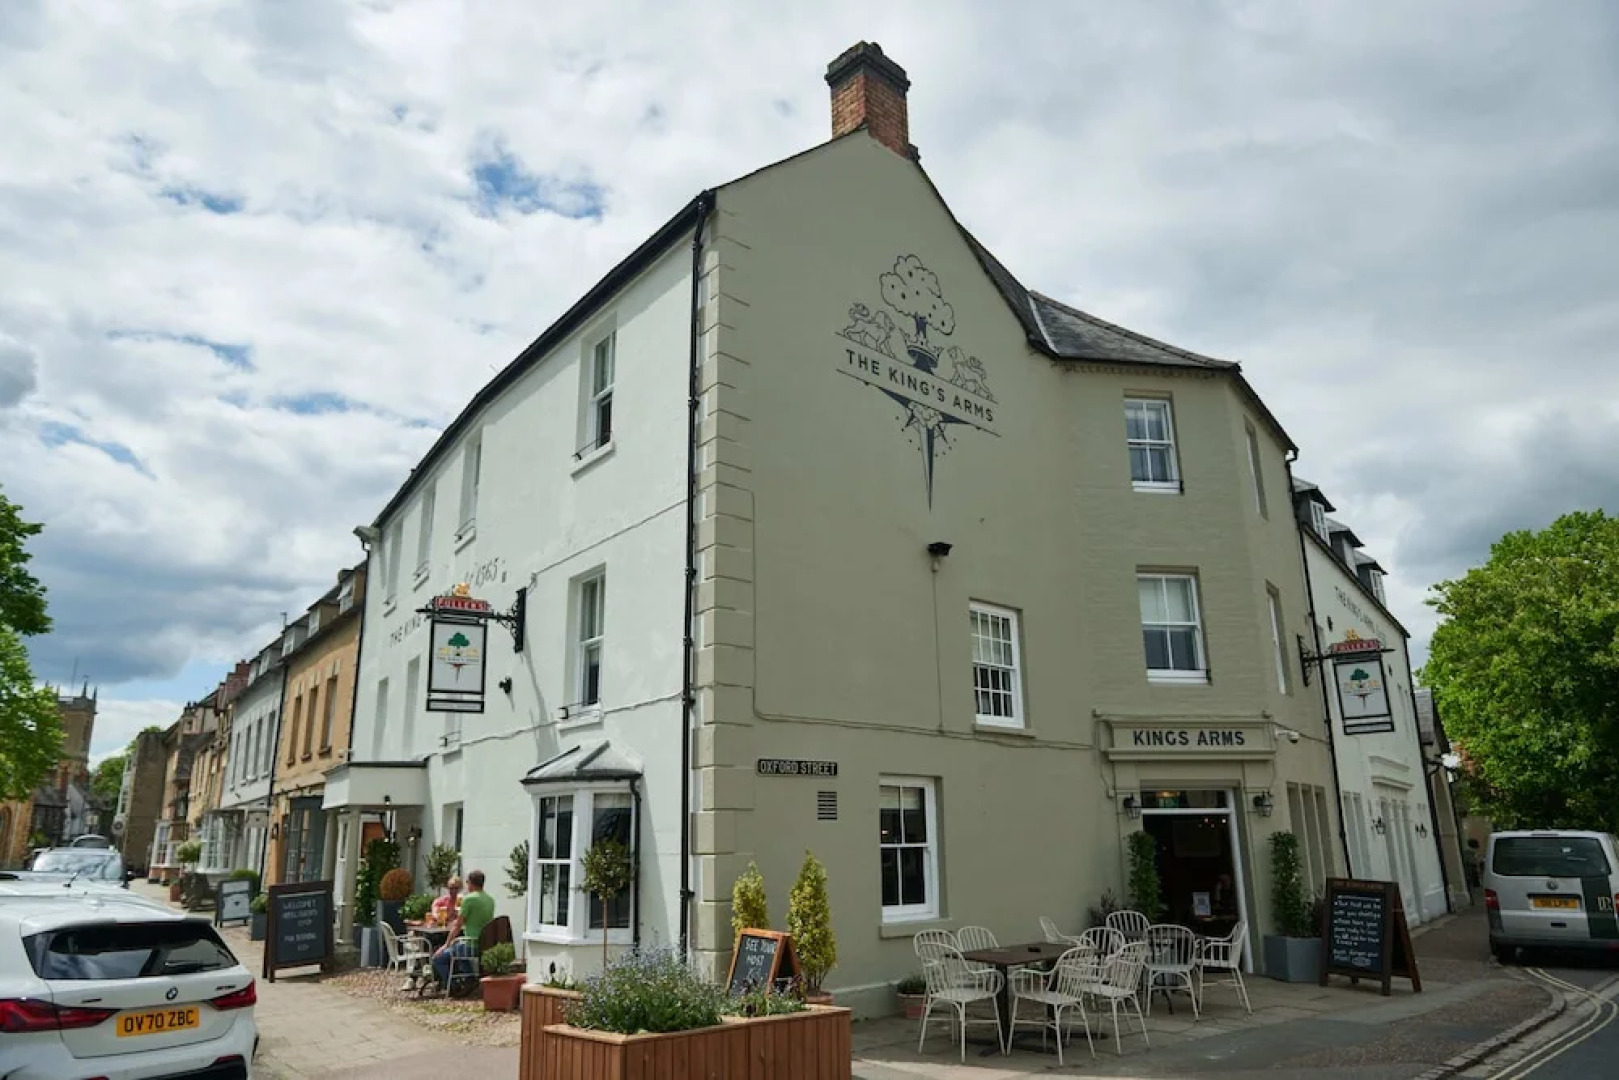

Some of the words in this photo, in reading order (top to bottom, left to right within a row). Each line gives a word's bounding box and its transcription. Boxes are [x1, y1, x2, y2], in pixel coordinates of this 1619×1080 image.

[845, 349, 881, 376] THE
[888, 367, 946, 403] KING'S
[953, 395, 994, 422] ARMS
[1132, 729, 1190, 747] KINGS
[1197, 730, 1246, 747] ARMS
[760, 760, 799, 774] OXFORD
[800, 762, 836, 775] STREET
[124, 1012, 165, 1033] OV70
[168, 1009, 194, 1028] ZBC
